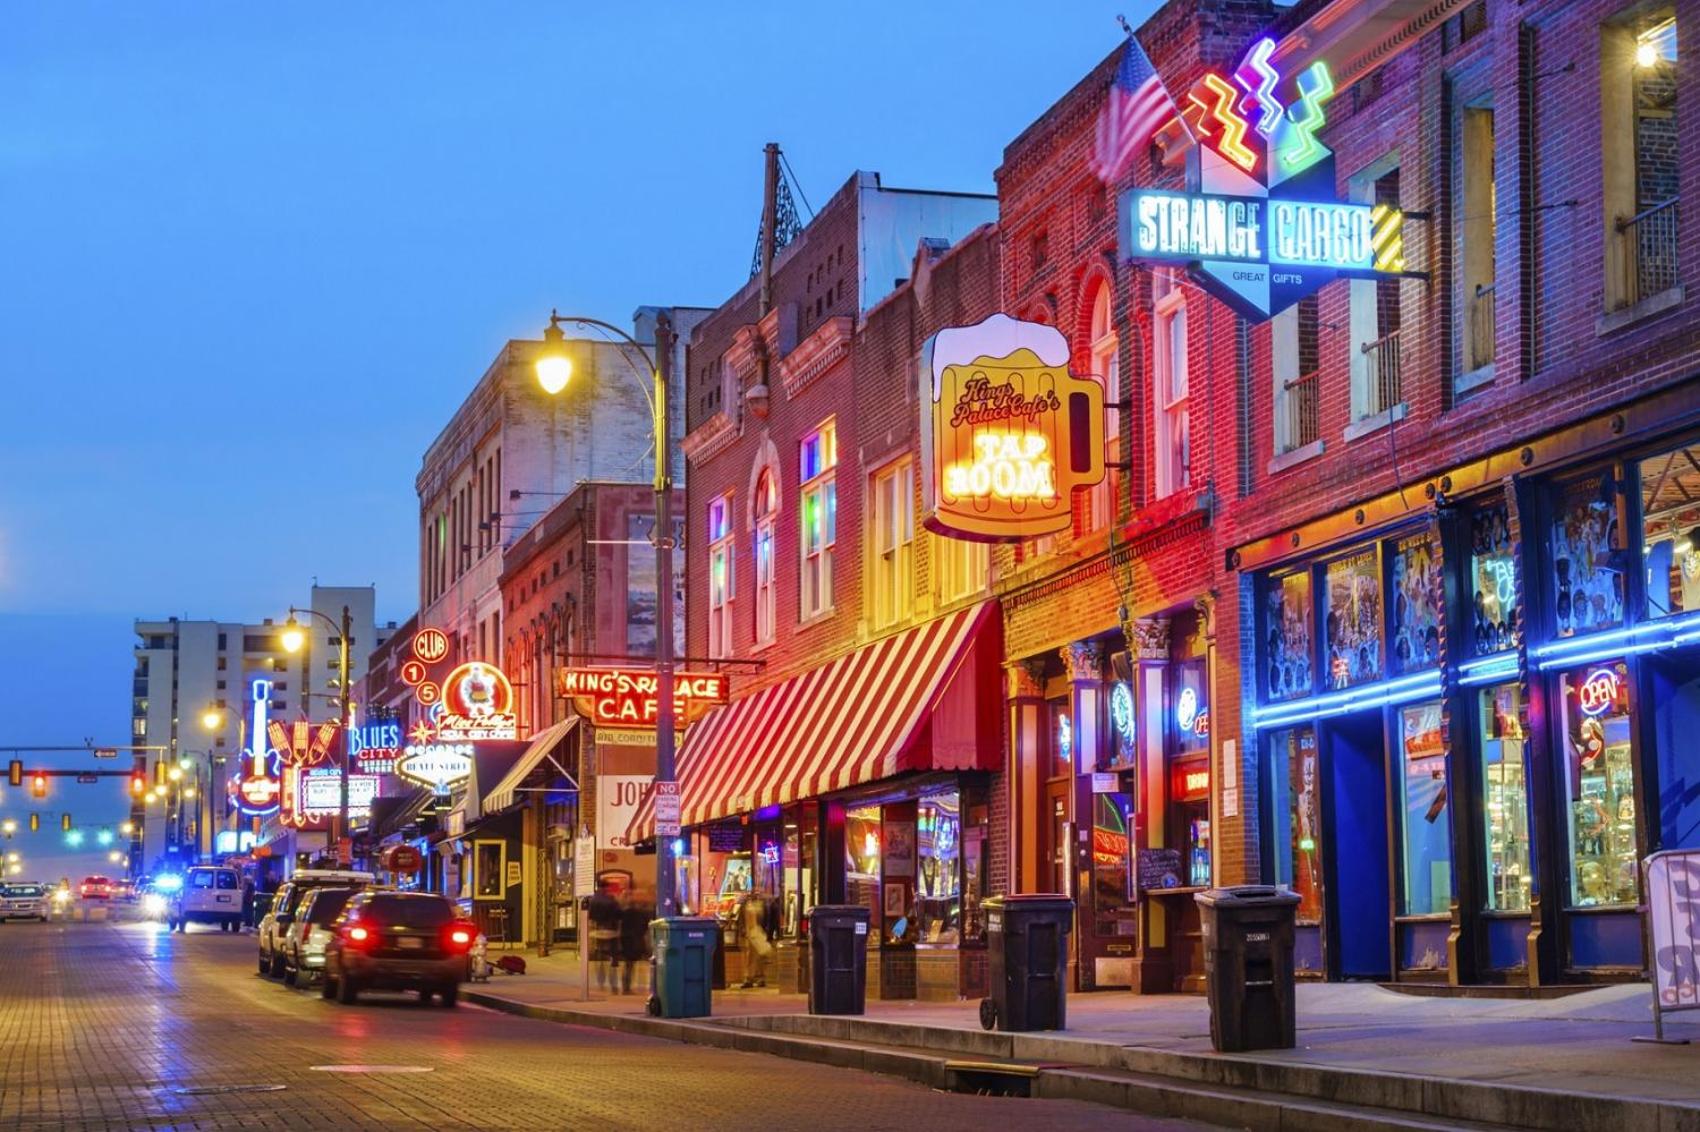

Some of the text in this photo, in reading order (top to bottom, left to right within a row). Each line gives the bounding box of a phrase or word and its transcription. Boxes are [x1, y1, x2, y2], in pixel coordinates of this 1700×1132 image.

[1139, 195, 1374, 264] STRANGE CARGO
[1232, 271, 1303, 284] GREAT GIFTS
[950, 402, 1012, 428] Palace
[974, 433, 1048, 460] TAP
[946, 460, 1056, 498] ROOM
[416, 632, 446, 659] CLUB
[408, 666, 418, 682] 1
[566, 671, 720, 698] KING'S PAACE
[422, 685, 435, 702] 5
[1580, 674, 1618, 707] OPEN
[1194, 714, 1209, 735] OPE
[350, 725, 399, 756] BLUES
[359, 748, 398, 759] CITY
[660, 784, 676, 793] NO
